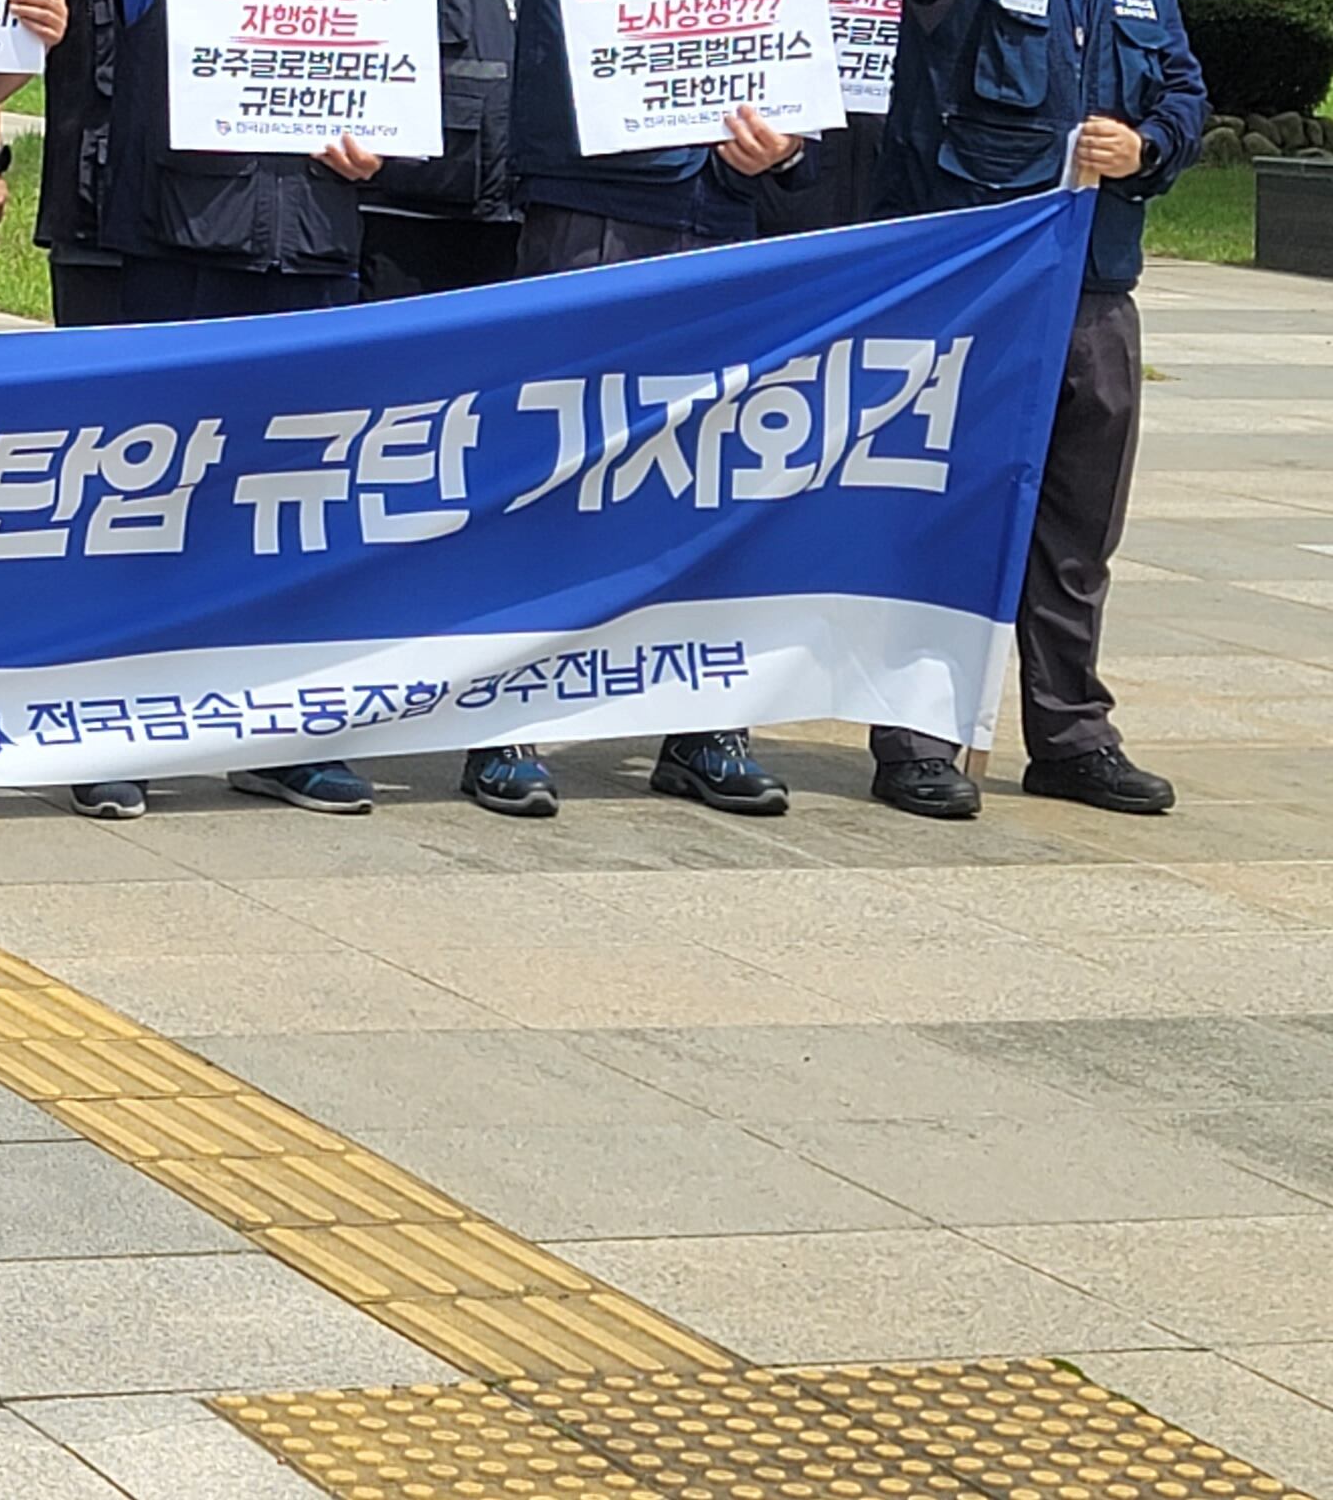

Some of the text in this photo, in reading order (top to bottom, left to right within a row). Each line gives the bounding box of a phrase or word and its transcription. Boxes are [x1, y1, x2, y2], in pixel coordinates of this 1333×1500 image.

[241, 5, 358, 36] 자행하는
[191, 46, 416, 83] 광주글로벌모터스
[591, 30, 813, 79] 광주글로벌모터스
[239, 86, 367, 118] 규탄한다!
[643, 71, 766, 111] 규탄한다!
[234, 390, 480, 555] 규탄
[503, 334, 975, 514] 기자회견
[26, 678, 449, 748] 전국금속노동조합
[454, 639, 750, 712] 광주전남지부
